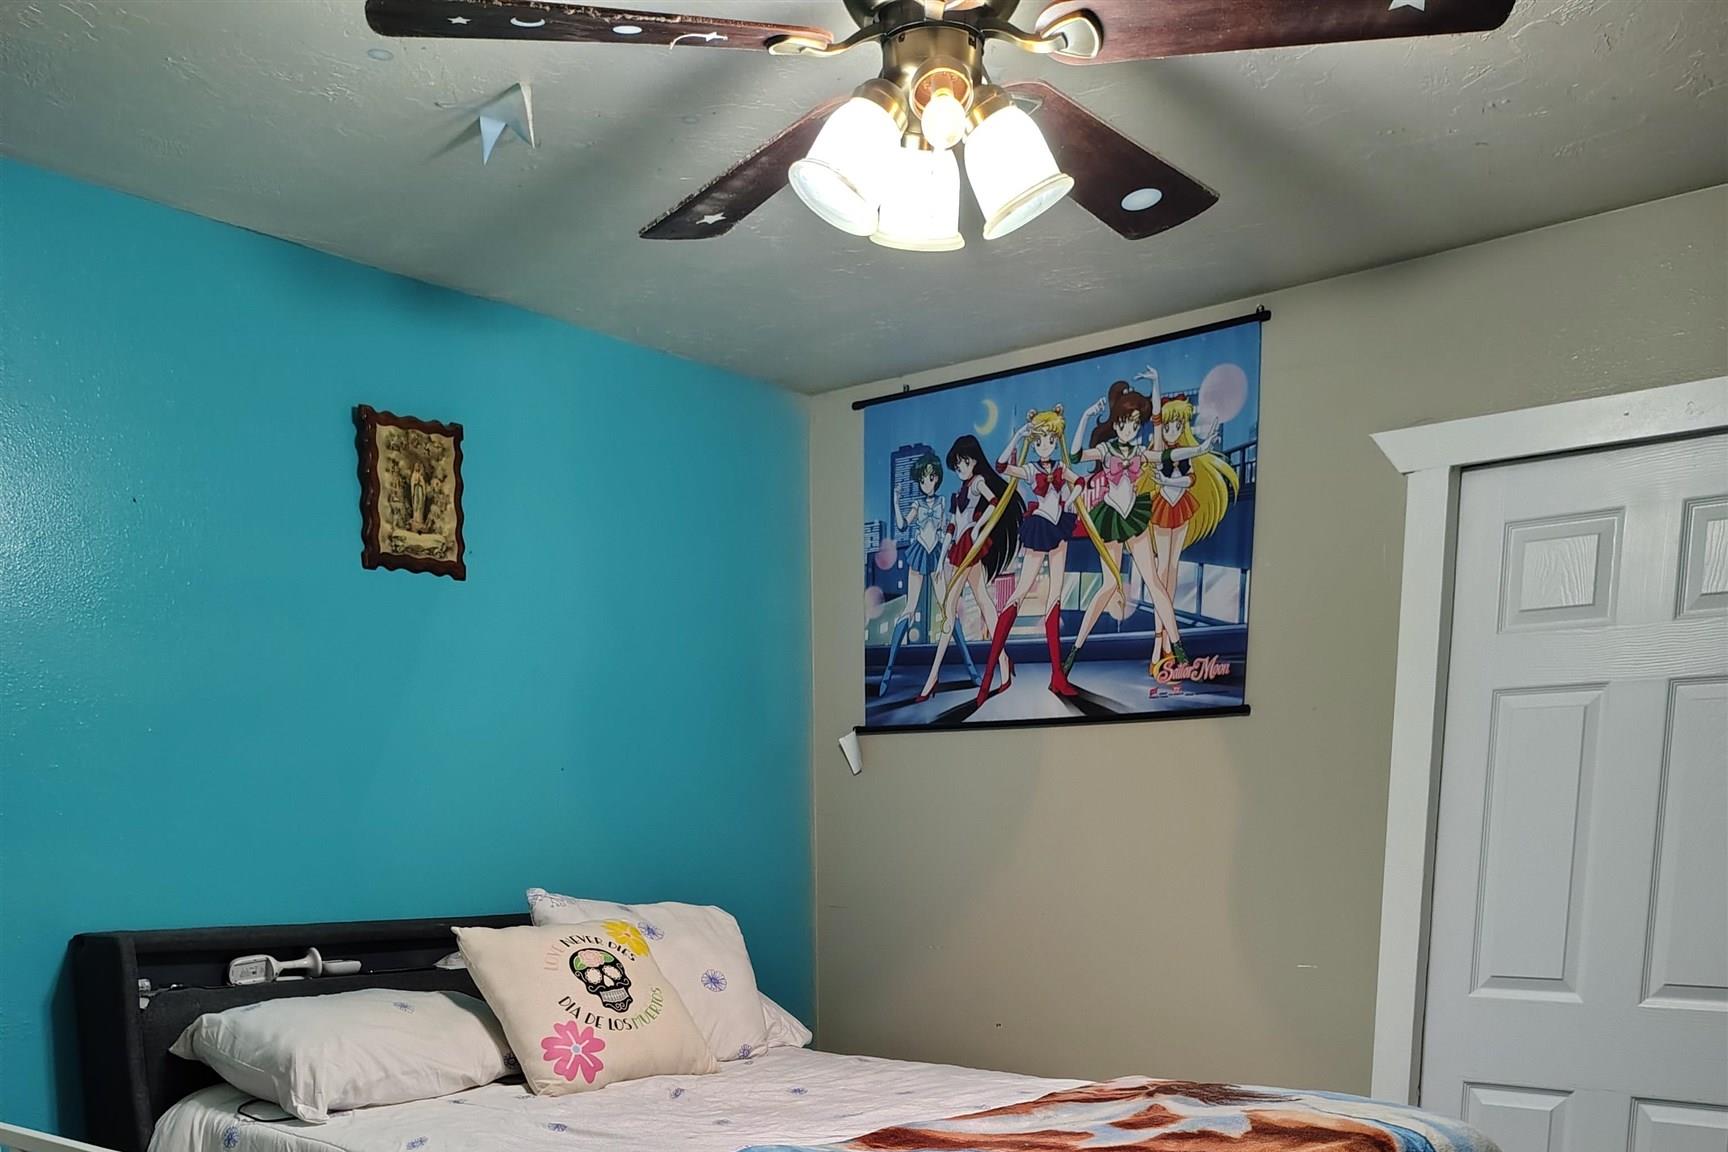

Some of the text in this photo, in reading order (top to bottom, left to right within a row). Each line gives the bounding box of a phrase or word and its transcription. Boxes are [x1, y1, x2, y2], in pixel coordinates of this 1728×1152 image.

[1190, 654, 1231, 682] Moon
[559, 934, 604, 948] NEVER
[608, 941, 636, 962] DIES
[558, 987, 664, 1031] DIA DE LOS MUERTOS
